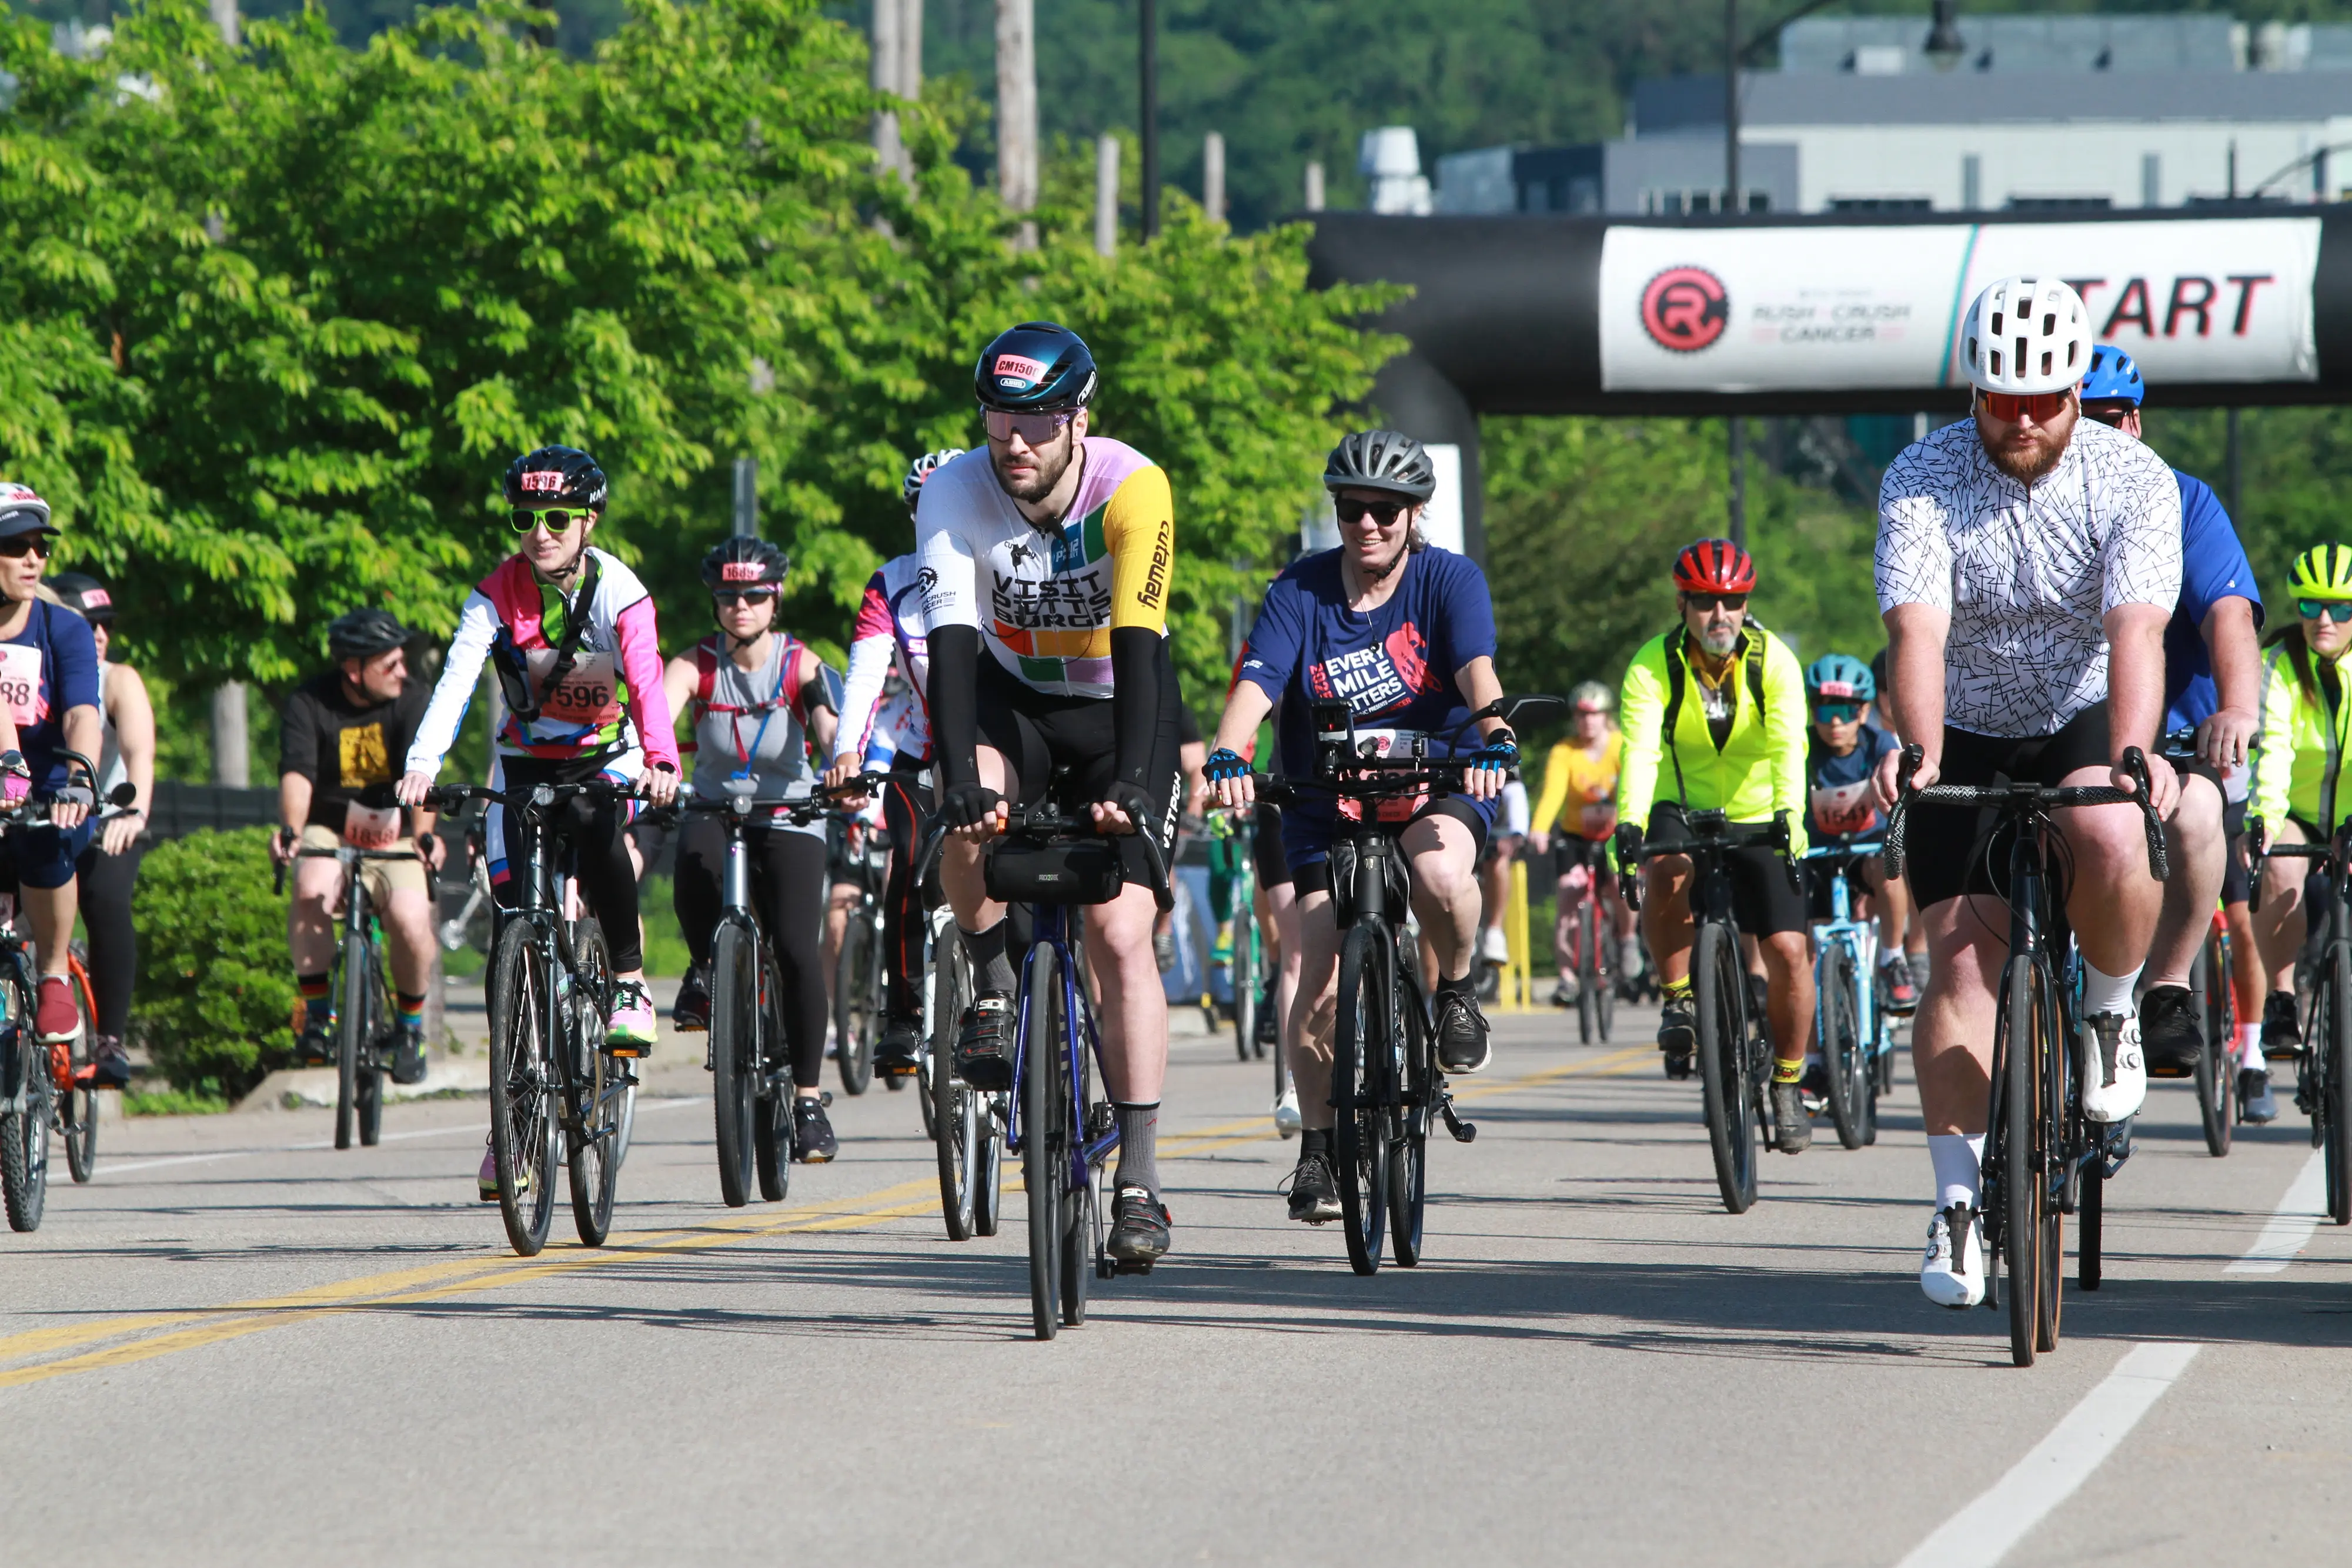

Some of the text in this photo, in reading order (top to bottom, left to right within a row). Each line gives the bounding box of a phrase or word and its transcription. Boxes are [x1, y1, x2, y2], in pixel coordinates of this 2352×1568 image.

[2062, 275, 2273, 340] TART
[998, 360, 1040, 377] CM1500
[526, 475, 557, 489] 1596
[1004, 540, 1036, 559] cuay
[1138, 520, 1170, 611] cutaway
[927, 591, 956, 603] CRUSH
[994, 570, 1099, 599] VISIT
[923, 599, 942, 613] NCER
[992, 588, 1112, 615] PITTS
[993, 604, 1111, 628] BURGH
[1325, 642, 1384, 677] EVERY
[1333, 659, 1395, 697] MILE
[556, 685, 610, 708] 596
[1350, 677, 1402, 711] TTERS
[1368, 700, 1388, 713] PRESENTS
[1163, 771, 1181, 849] vSTPGH
